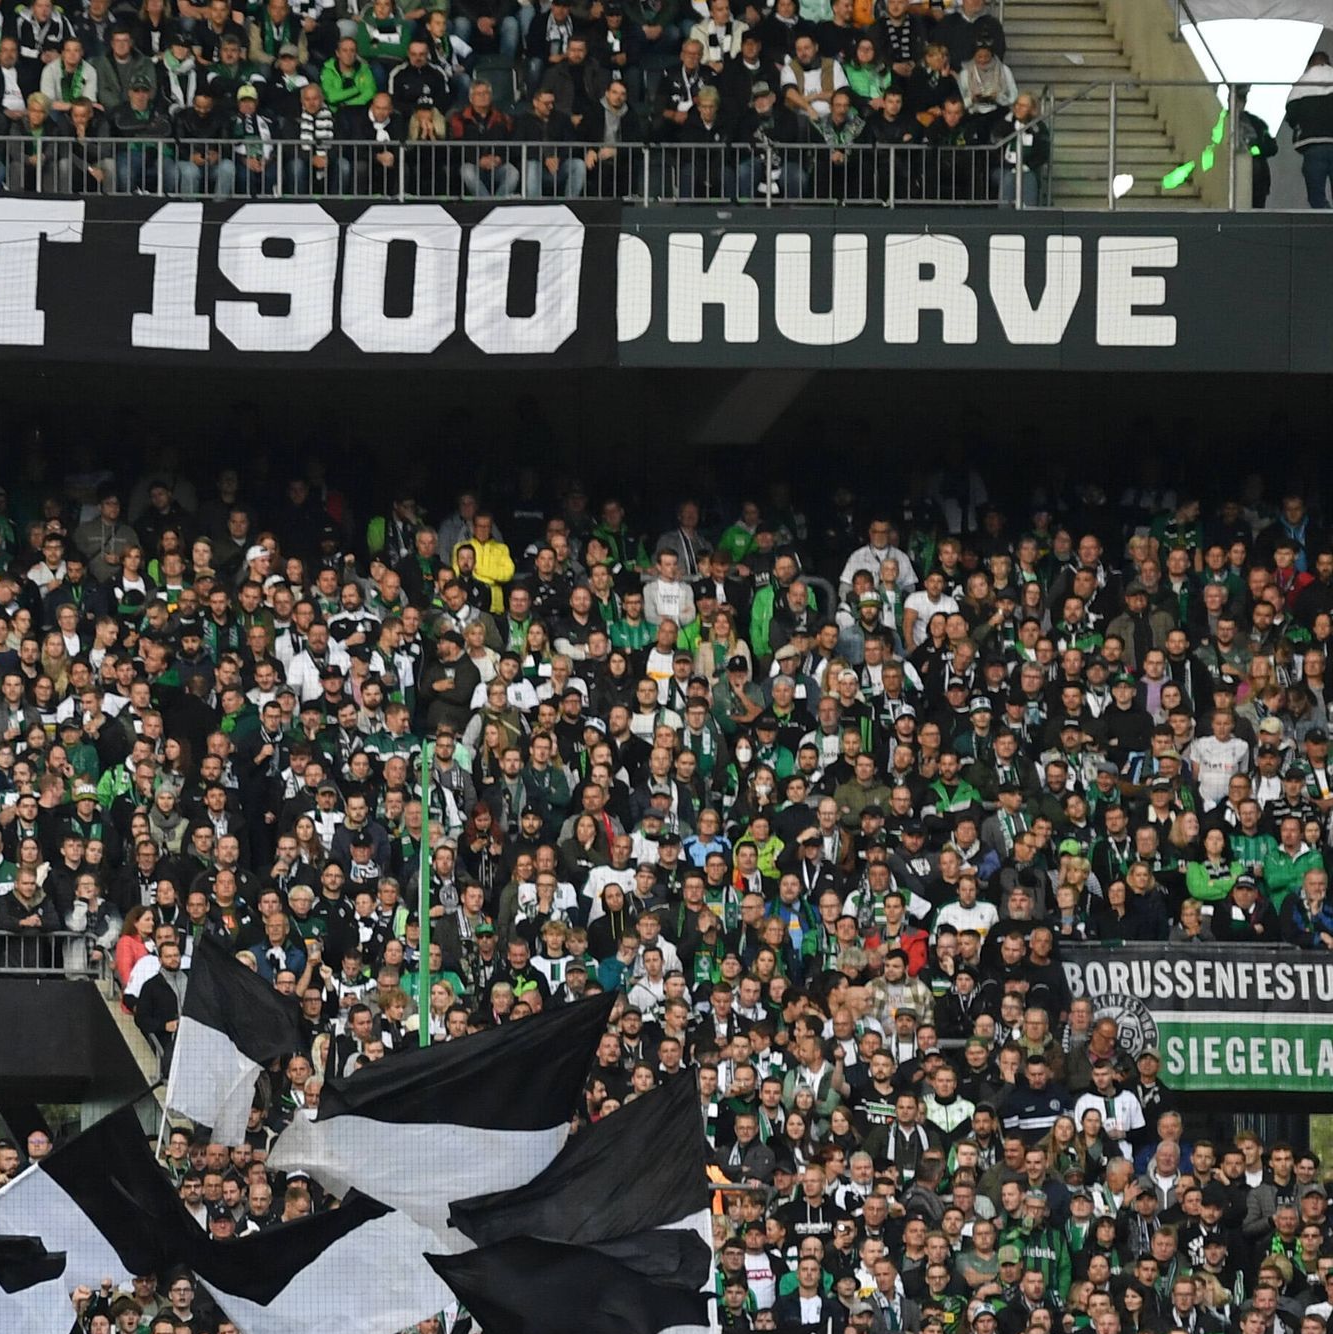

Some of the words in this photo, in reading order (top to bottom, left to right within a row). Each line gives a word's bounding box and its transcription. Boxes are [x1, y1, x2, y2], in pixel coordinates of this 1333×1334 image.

[131, 202, 585, 353] 1900
[1062, 960, 1333, 1001] BORUSSENFESTU
[1167, 1036, 1333, 1077] SIEGERLA
